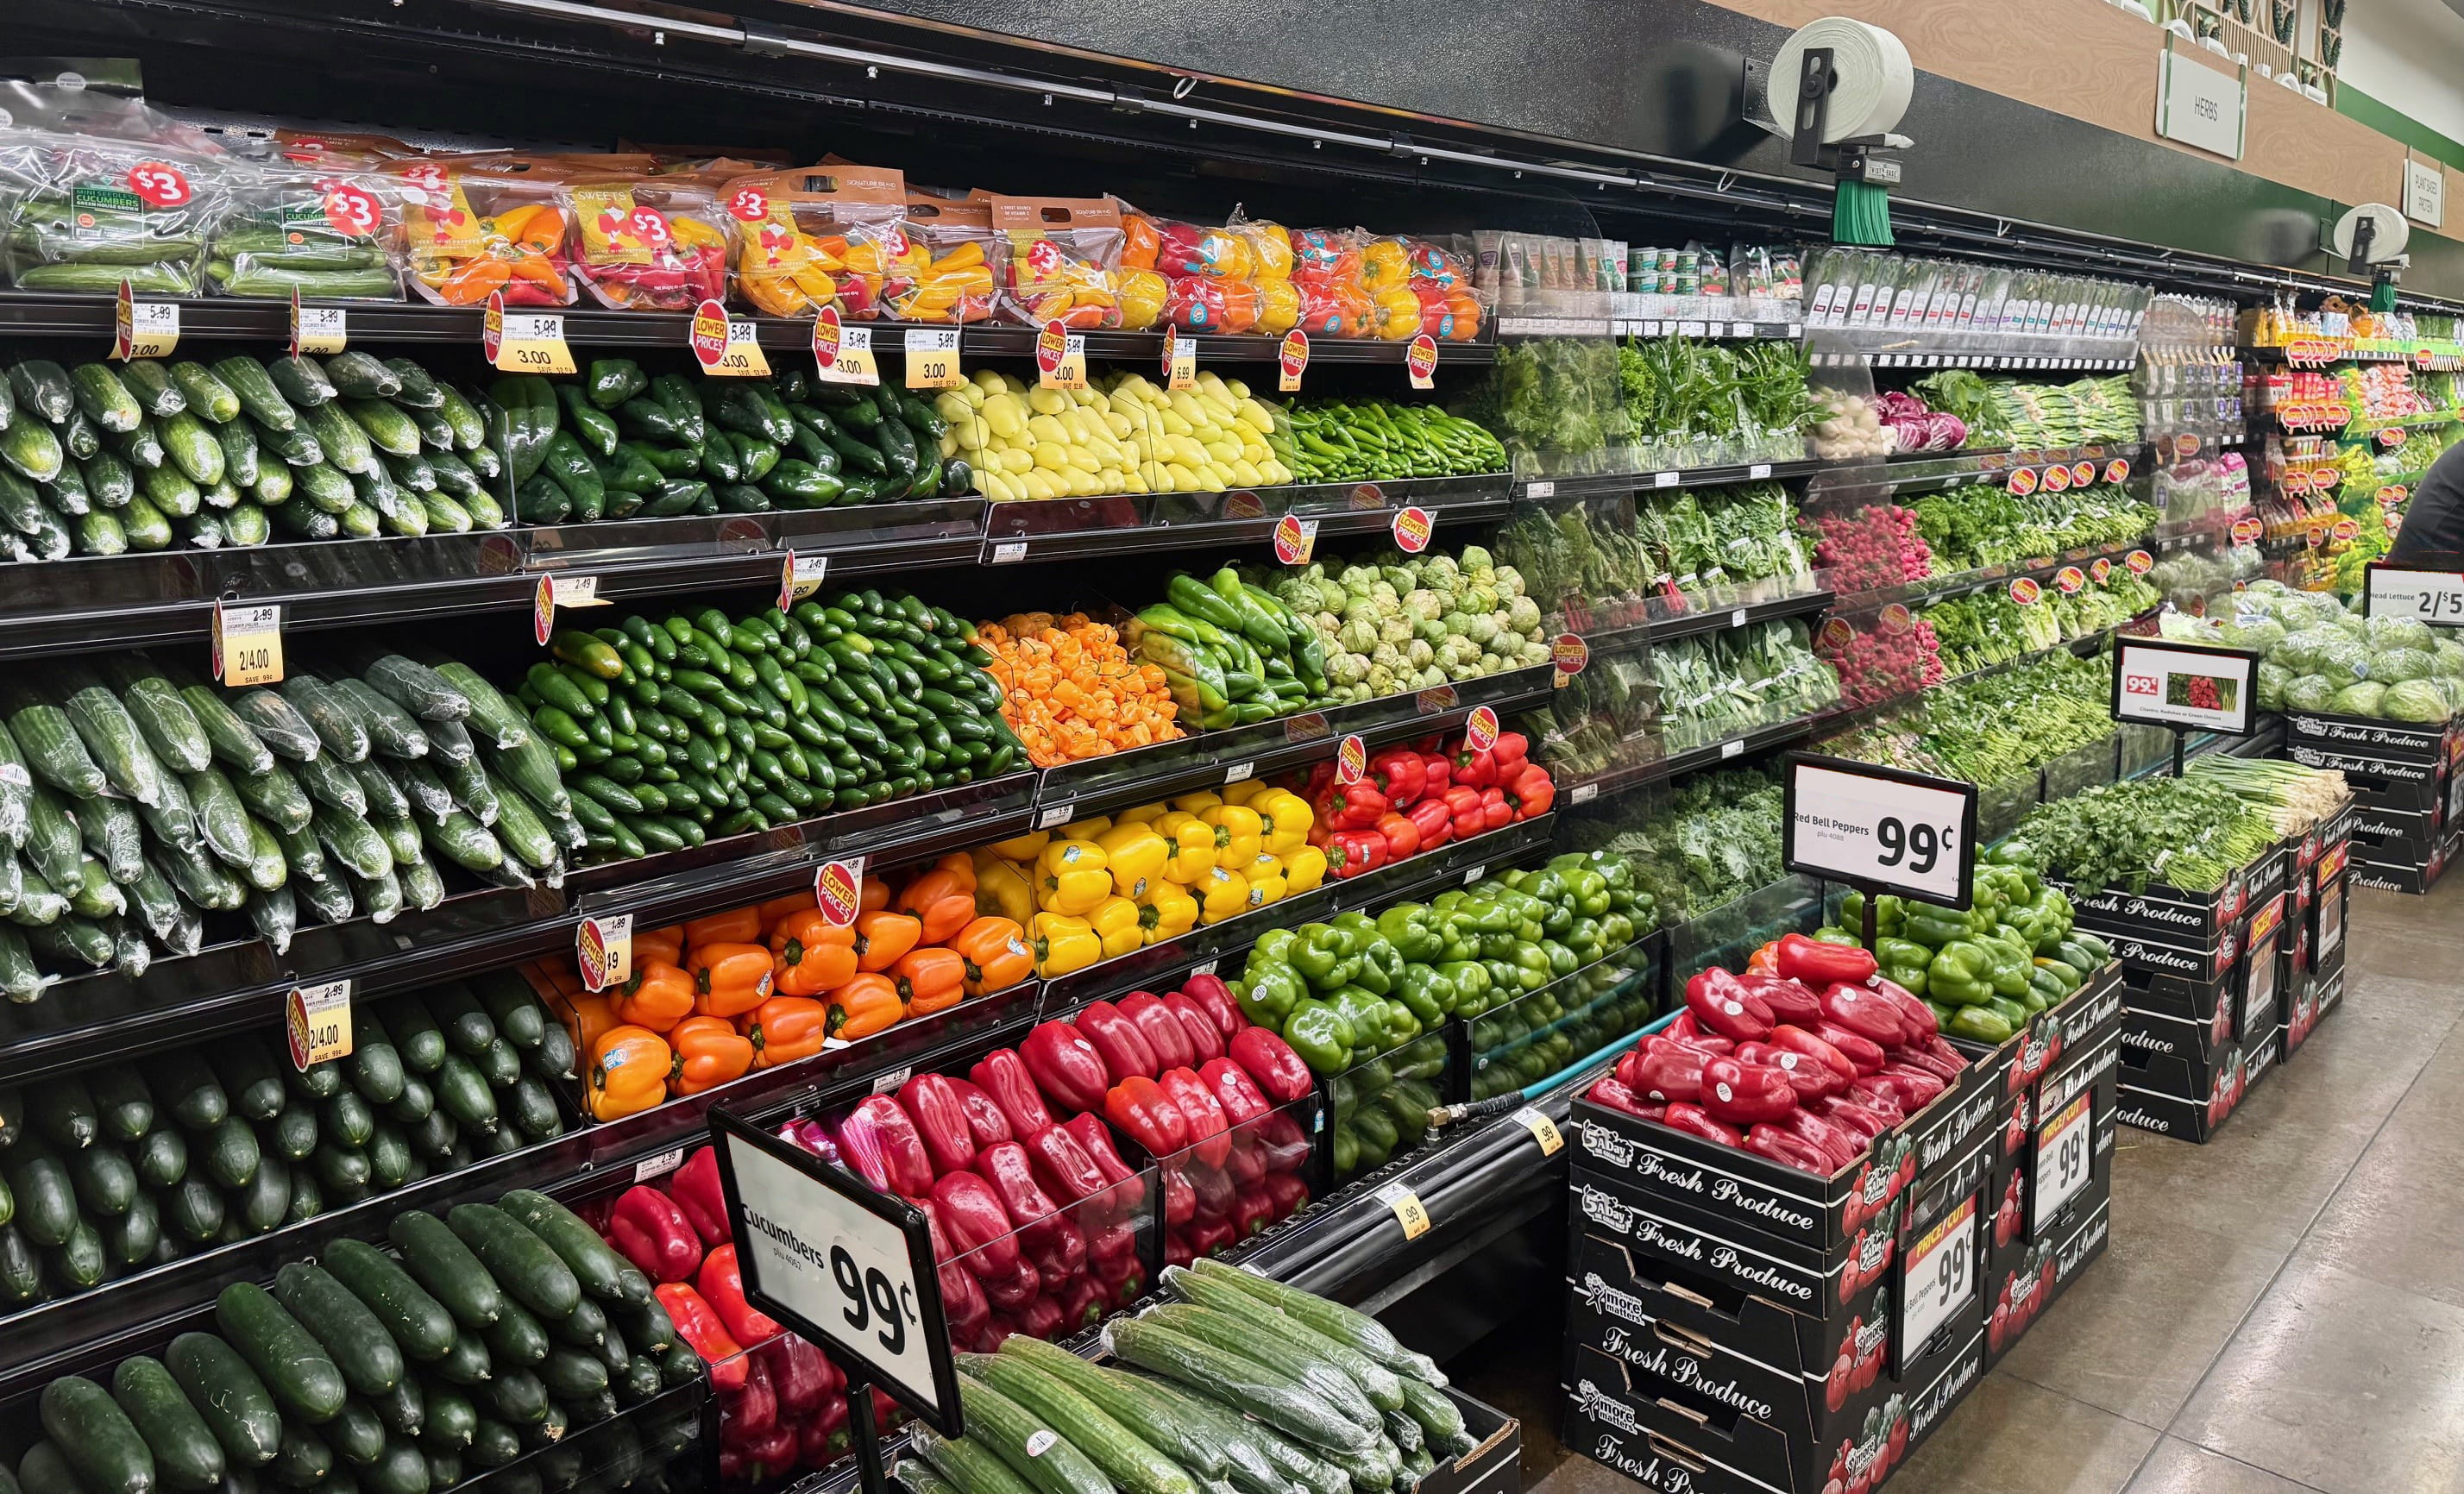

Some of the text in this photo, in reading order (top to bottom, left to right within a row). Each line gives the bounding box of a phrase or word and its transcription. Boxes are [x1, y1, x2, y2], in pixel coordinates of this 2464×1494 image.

[2195, 97, 2217, 121] HERBS
[136, 169, 182, 200] $3
[76, 195, 139, 207] CUCUMBERS
[578, 191, 627, 201] SWEETS
[736, 189, 763, 216] $3
[333, 191, 373, 226] $3
[634, 212, 666, 242] $3
[150, 305, 171, 319] 5.99
[320, 311, 337, 323] 5.99
[534, 320, 556, 337] 5.99
[696, 318, 725, 336] LOWER
[732, 325, 751, 341] 5.99
[817, 323, 839, 340] LOWER
[696, 335, 724, 351] PRICES
[816, 339, 837, 355] PRICES
[848, 332, 866, 348] 5.99
[939, 333, 954, 348] 5.99
[1041, 334, 1064, 350] LOWER
[1067, 339, 1080, 353] 5.99
[1285, 342, 1305, 357] LOWER
[518, 350, 551, 364] 3.00
[722, 355, 749, 367] 3.00
[1040, 348, 1061, 363] PRICES
[1283, 354, 1304, 368] PRICES
[1410, 357, 1431, 372] PRICES
[1411, 348, 1434, 362] LOWER
[837, 358, 862, 375] 3.00
[923, 363, 946, 379] 3.00
[1055, 366, 1073, 380] 3.00
[1177, 367, 1190, 380] 6.99
[1280, 527, 1301, 548] LOWER
[1398, 527, 1424, 546] PRICES
[1400, 516, 1428, 538] LOWER
[1278, 539, 1297, 556] PRICES
[253, 608, 273, 622] 2.99
[240, 648, 269, 671] 2/4.00
[1555, 646, 1584, 656] LOWER
[1556, 656, 1583, 665] PRICES
[1470, 725, 1492, 744] PRICES
[1473, 716, 1495, 735] LOWER
[2329, 726, 2429, 748] Fresh Produce
[1344, 744, 1363, 767] LOWER
[1342, 756, 1360, 778] PRICES
[2326, 757, 2425, 780] Fresh Produce
[1813, 816, 1830, 828] Bell
[1832, 820, 1870, 836] Peppers
[1817, 829, 1827, 838] plu
[2352, 817, 2404, 838] Produce
[823, 871, 855, 908] LOWER
[2349, 870, 2402, 892] Produce
[820, 886, 852, 919] PRICES
[2124, 896, 2202, 926] Produce
[581, 929, 604, 965] LOWER
[2122, 940, 2198, 971] Produce
[580, 945, 602, 982] PRICES
[324, 984, 343, 998] 2.99
[2064, 995, 2119, 1049] Fresh Produce
[311, 1024, 338, 1049] 2/4.00
[2121, 1031, 2175, 1054] oduce
[314, 1052, 329, 1062] SAVE
[2117, 1108, 2170, 1132] oduce
[1585, 1129, 1625, 1158] 5 A Day
[1637, 1153, 1813, 1230] Fresh Produce
[1585, 1194, 1625, 1222] 5 A Day
[740, 1202, 825, 1271] Cucumbers
[773, 1246, 802, 1272] plu 4062
[1636, 1220, 1812, 1300] Fresh Produce
[1939, 1226, 1971, 1307] 99¢
[829, 1244, 916, 1357] 99¢
[1918, 1277, 1936, 1303] Peppers
[1606, 1293, 1641, 1315] more
[1865, 1320, 1884, 1345] more
[1602, 1327, 1772, 1419] Fresh Produce
[1909, 1355, 1978, 1441] Fresh Produce
[1600, 1400, 1635, 1423] more
[1595, 1434, 1659, 1485] Fresh
